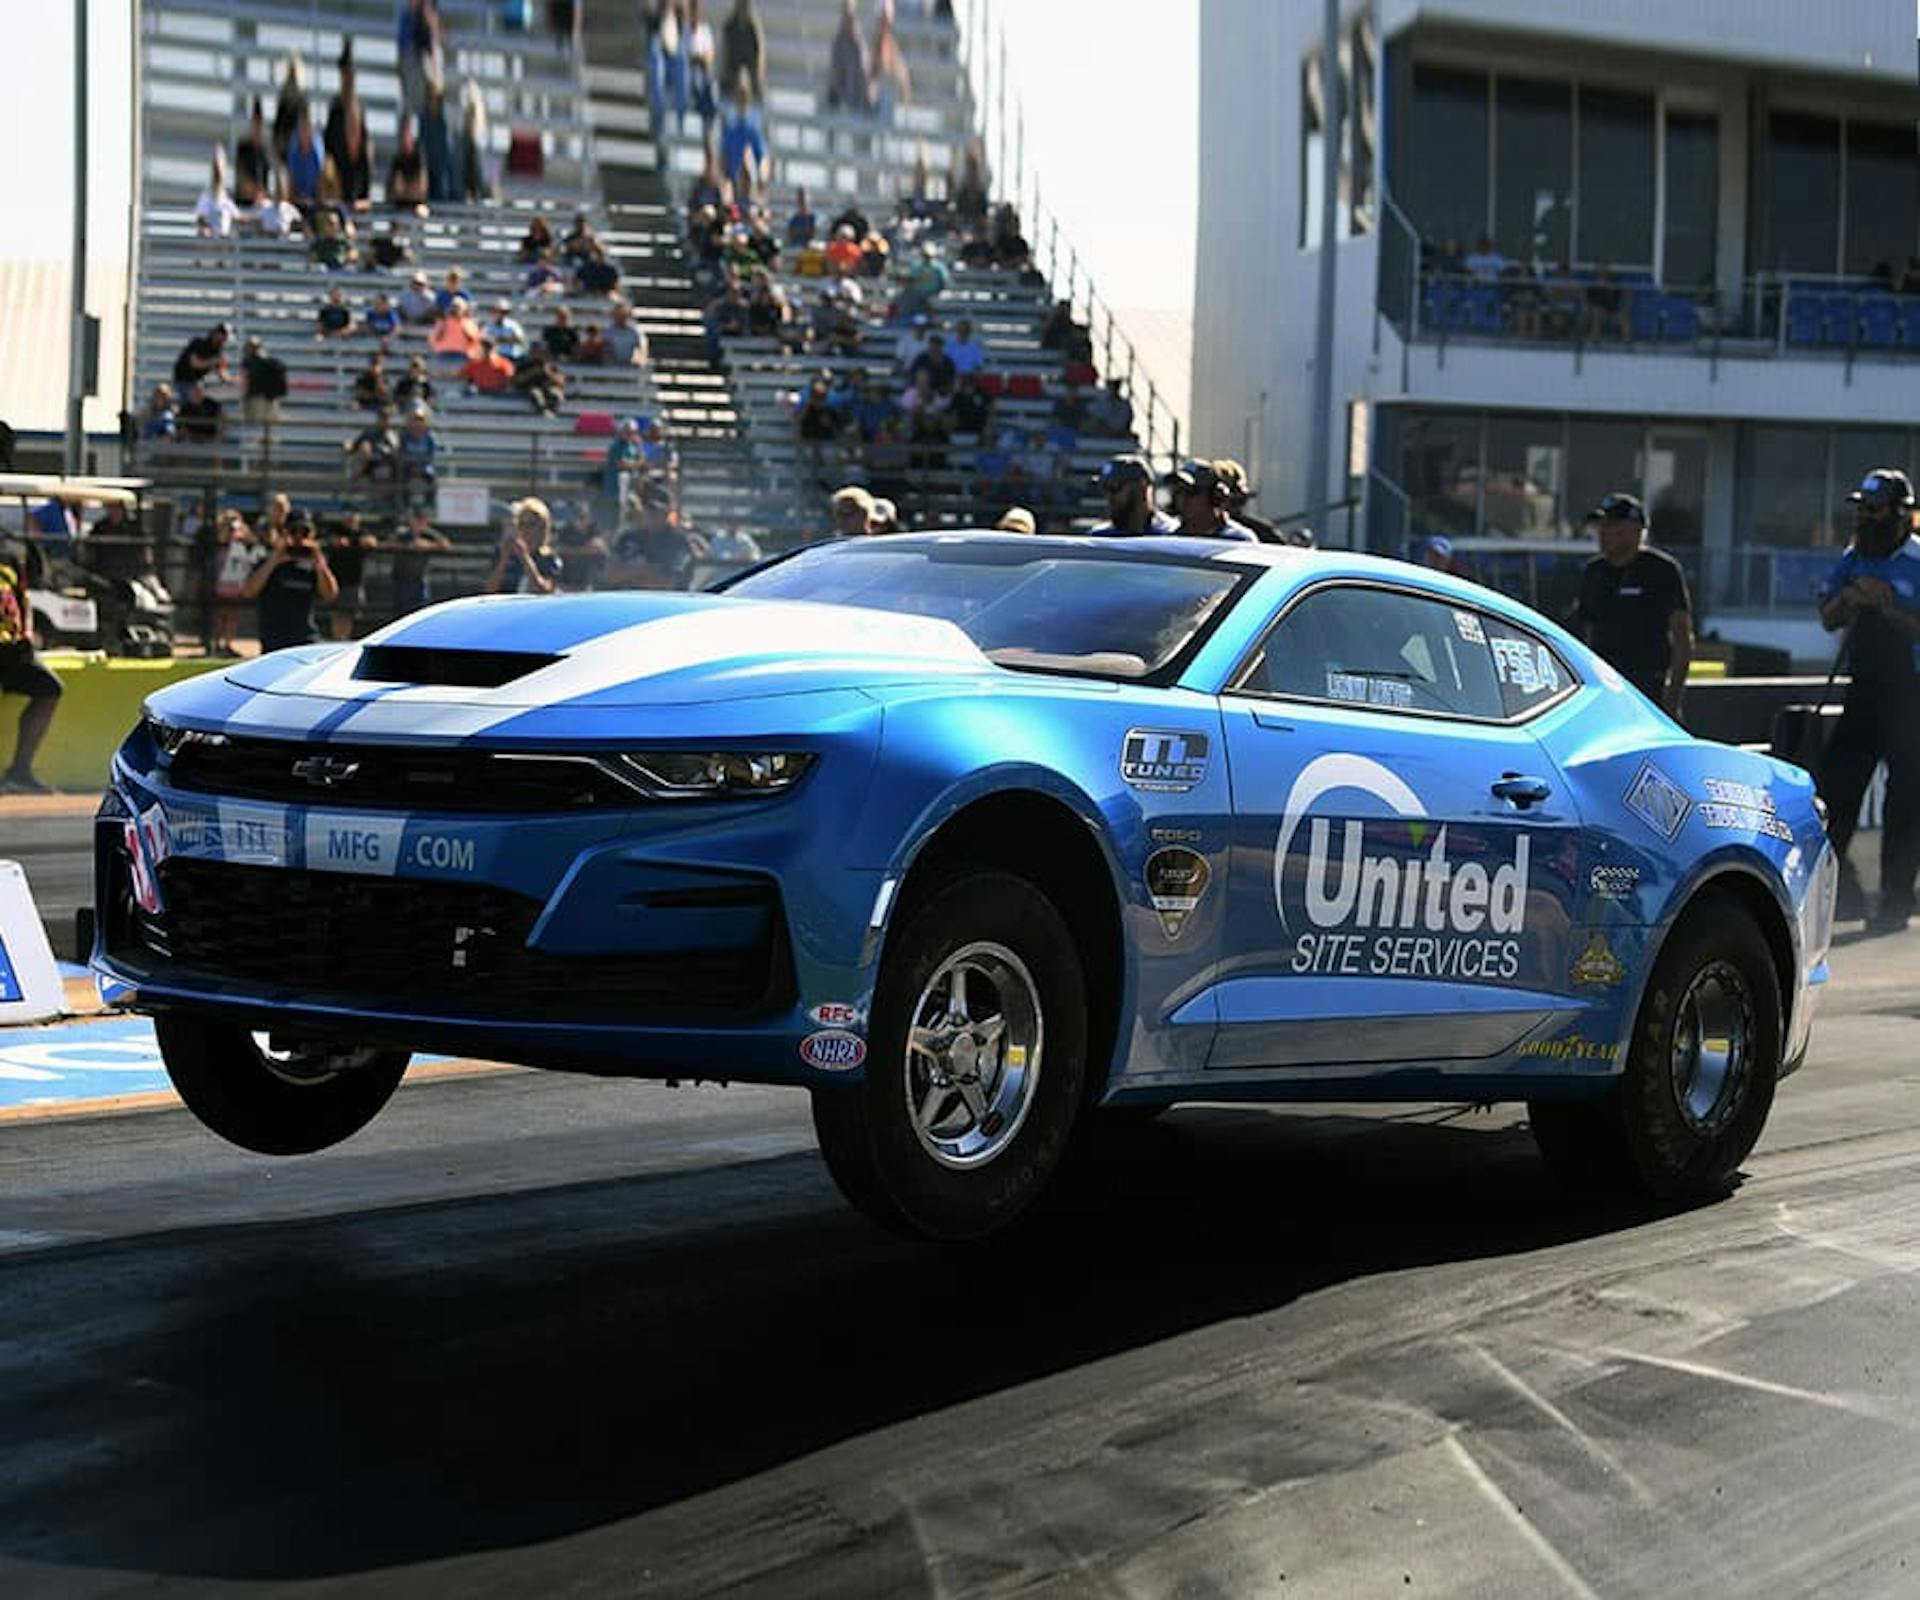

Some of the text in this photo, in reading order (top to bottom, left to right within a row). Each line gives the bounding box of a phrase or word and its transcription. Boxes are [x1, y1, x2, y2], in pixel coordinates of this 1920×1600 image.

[328, 829, 380, 861] MFG
[1305, 818, 1531, 934] United
[1291, 933, 1520, 978] SITE SERVICES
[811, 1039, 857, 1061] NHRA
